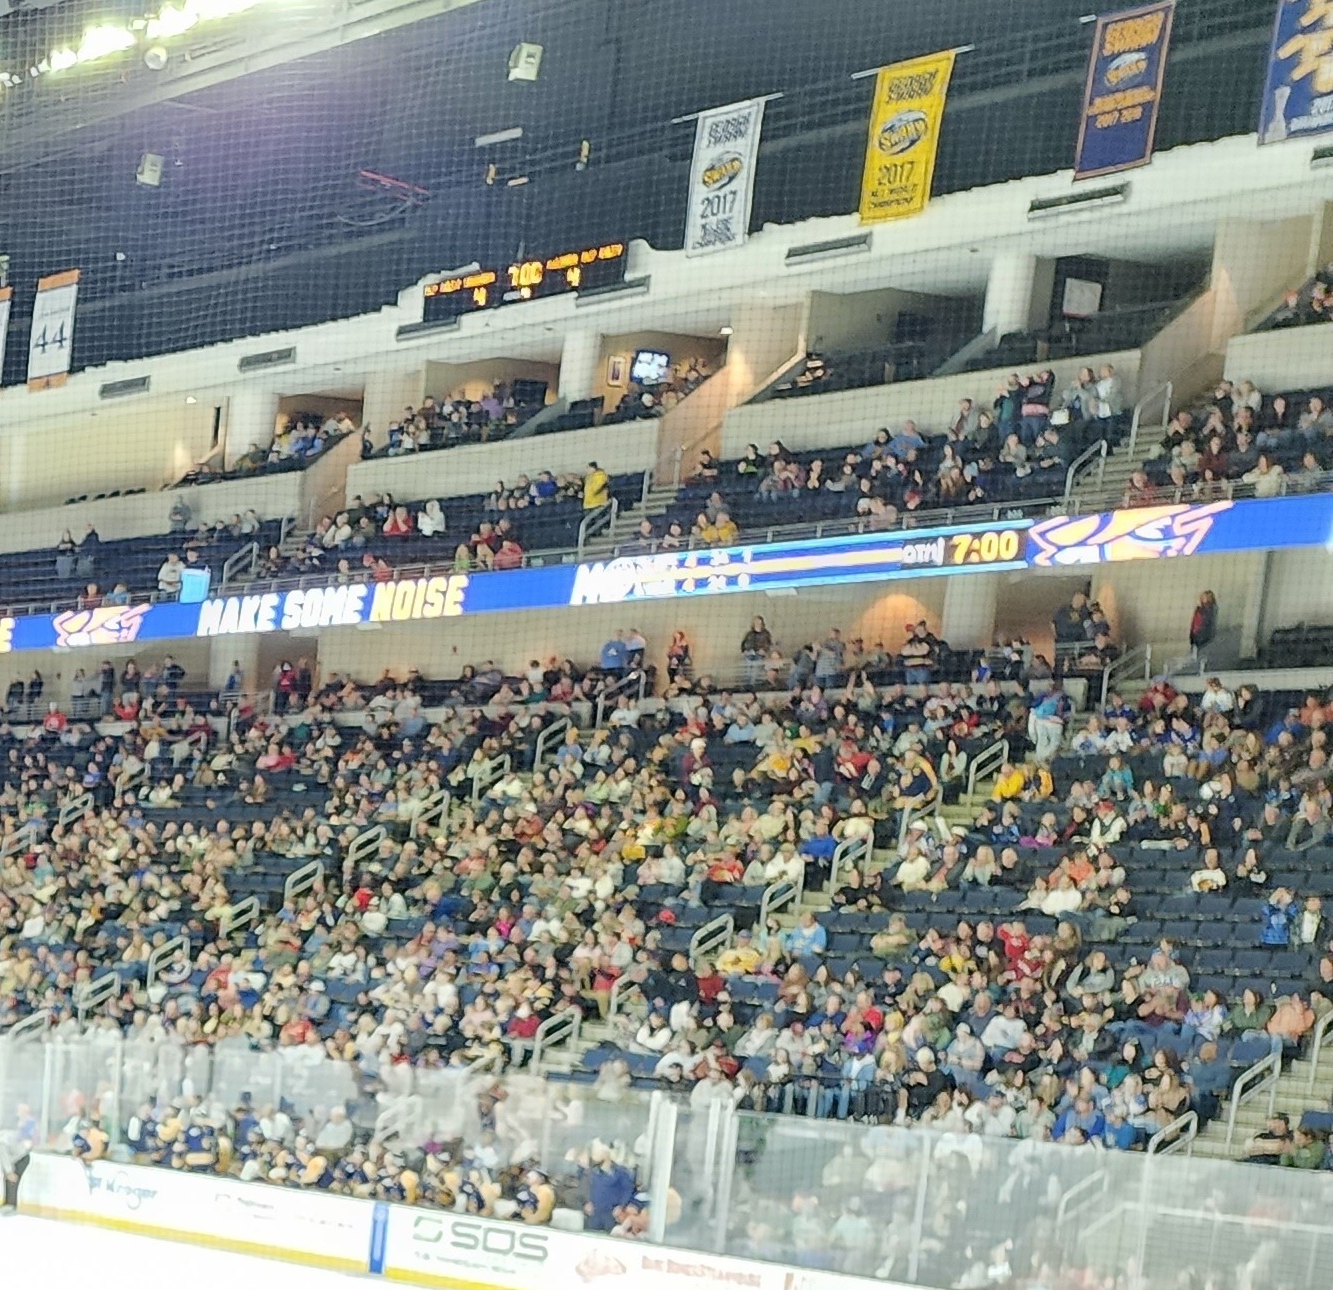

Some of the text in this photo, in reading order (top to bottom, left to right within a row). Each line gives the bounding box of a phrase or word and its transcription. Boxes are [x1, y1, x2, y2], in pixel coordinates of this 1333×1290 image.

[878, 161, 915, 186] 2017
[701, 190, 737, 219] 2017
[35, 320, 67, 354] 44
[951, 530, 1019, 564] 7:00
[196, 575, 468, 636] MAKE SOME NOISE
[450, 1221, 549, 1262] SOS
